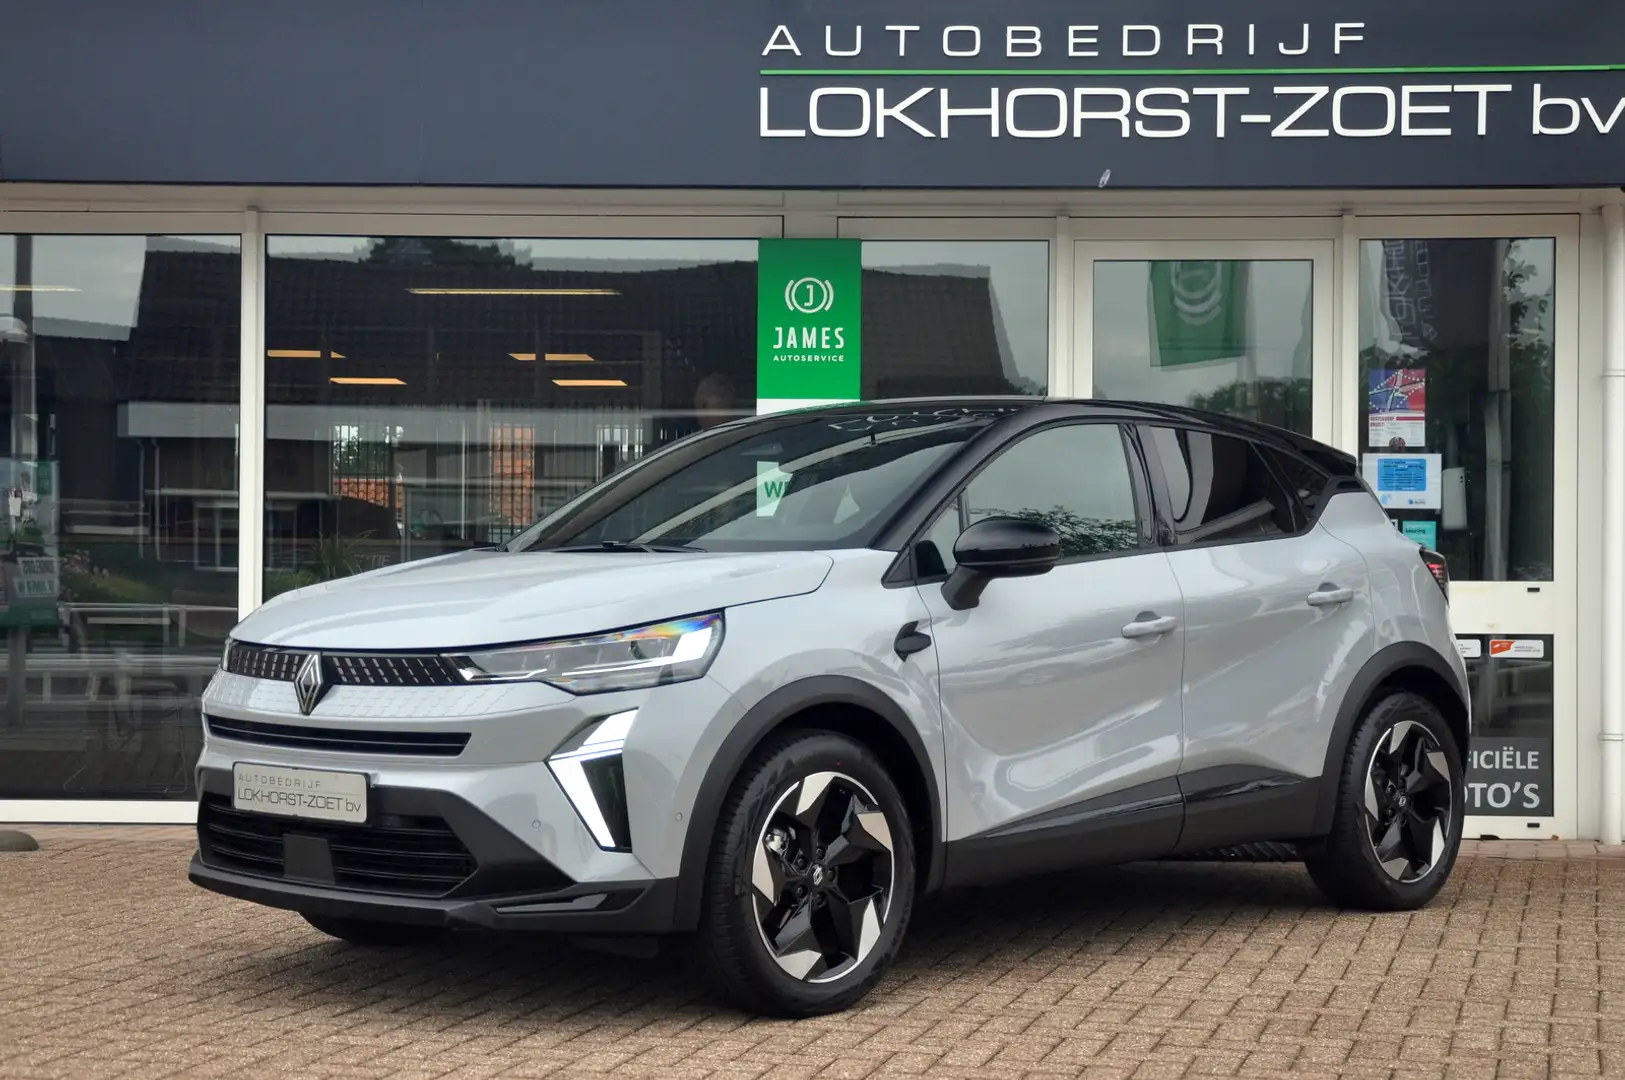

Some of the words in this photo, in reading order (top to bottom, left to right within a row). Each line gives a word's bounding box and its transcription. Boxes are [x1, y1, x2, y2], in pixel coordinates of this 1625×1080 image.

[761, 22, 1366, 58] AUTOBEDRIJF
[759, 83, 1513, 139] LOKHORST-ZOET
[1532, 83, 1625, 136] bv
[772, 326, 845, 349] JAMES
[772, 354, 845, 362] AUTOSERVICE
[1468, 746, 1540, 770] ICIËLE
[237, 772, 321, 789] AUTOBEDRIJF
[237, 788, 343, 811] LOKHORST-ZOET
[344, 798, 362, 813] bv
[1464, 781, 1541, 809] TO'S
